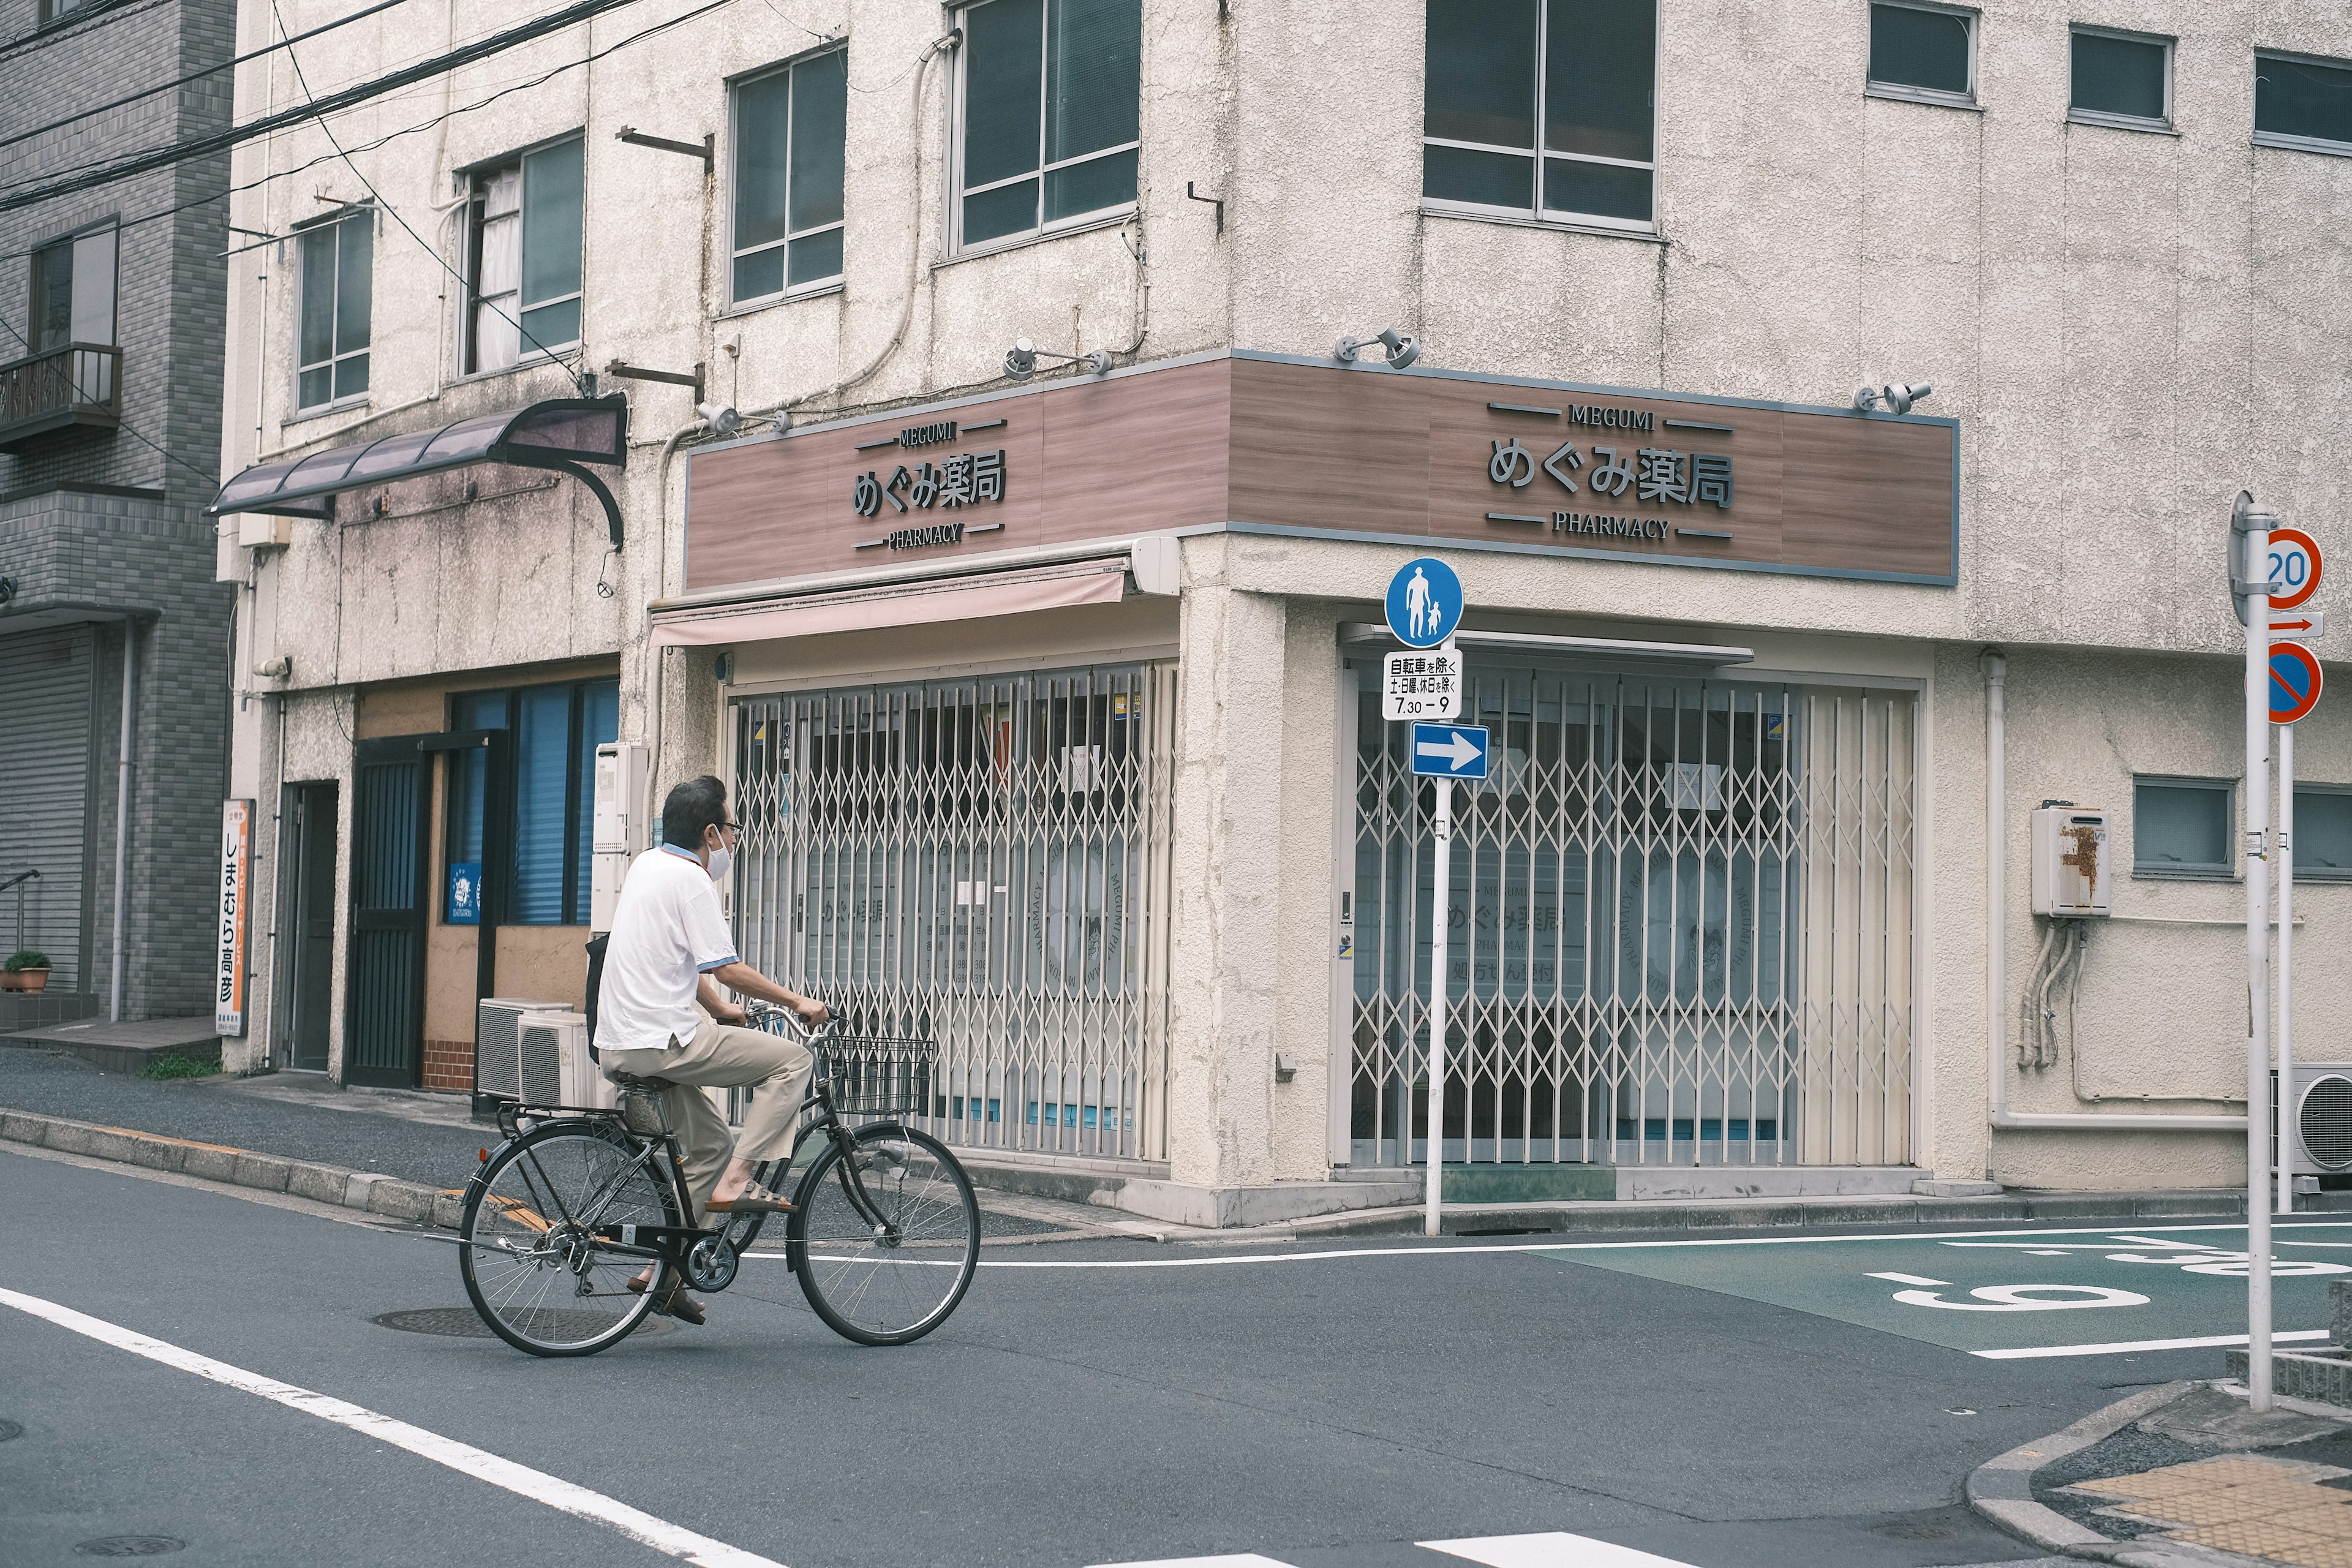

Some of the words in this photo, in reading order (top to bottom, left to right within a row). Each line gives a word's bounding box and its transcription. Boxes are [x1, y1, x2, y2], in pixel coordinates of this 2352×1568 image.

[1568, 404, 1656, 431] MEGUMI
[900, 421, 957, 447] MEGUMI
[853, 450, 1006, 516] めぐみ薬局
[1488, 438, 1735, 508] めぐみ薬局
[889, 523, 964, 549] PHARMACY
[1553, 511, 1671, 539] PHARMACY
[1391, 657, 1455, 674] 自転車を除く
